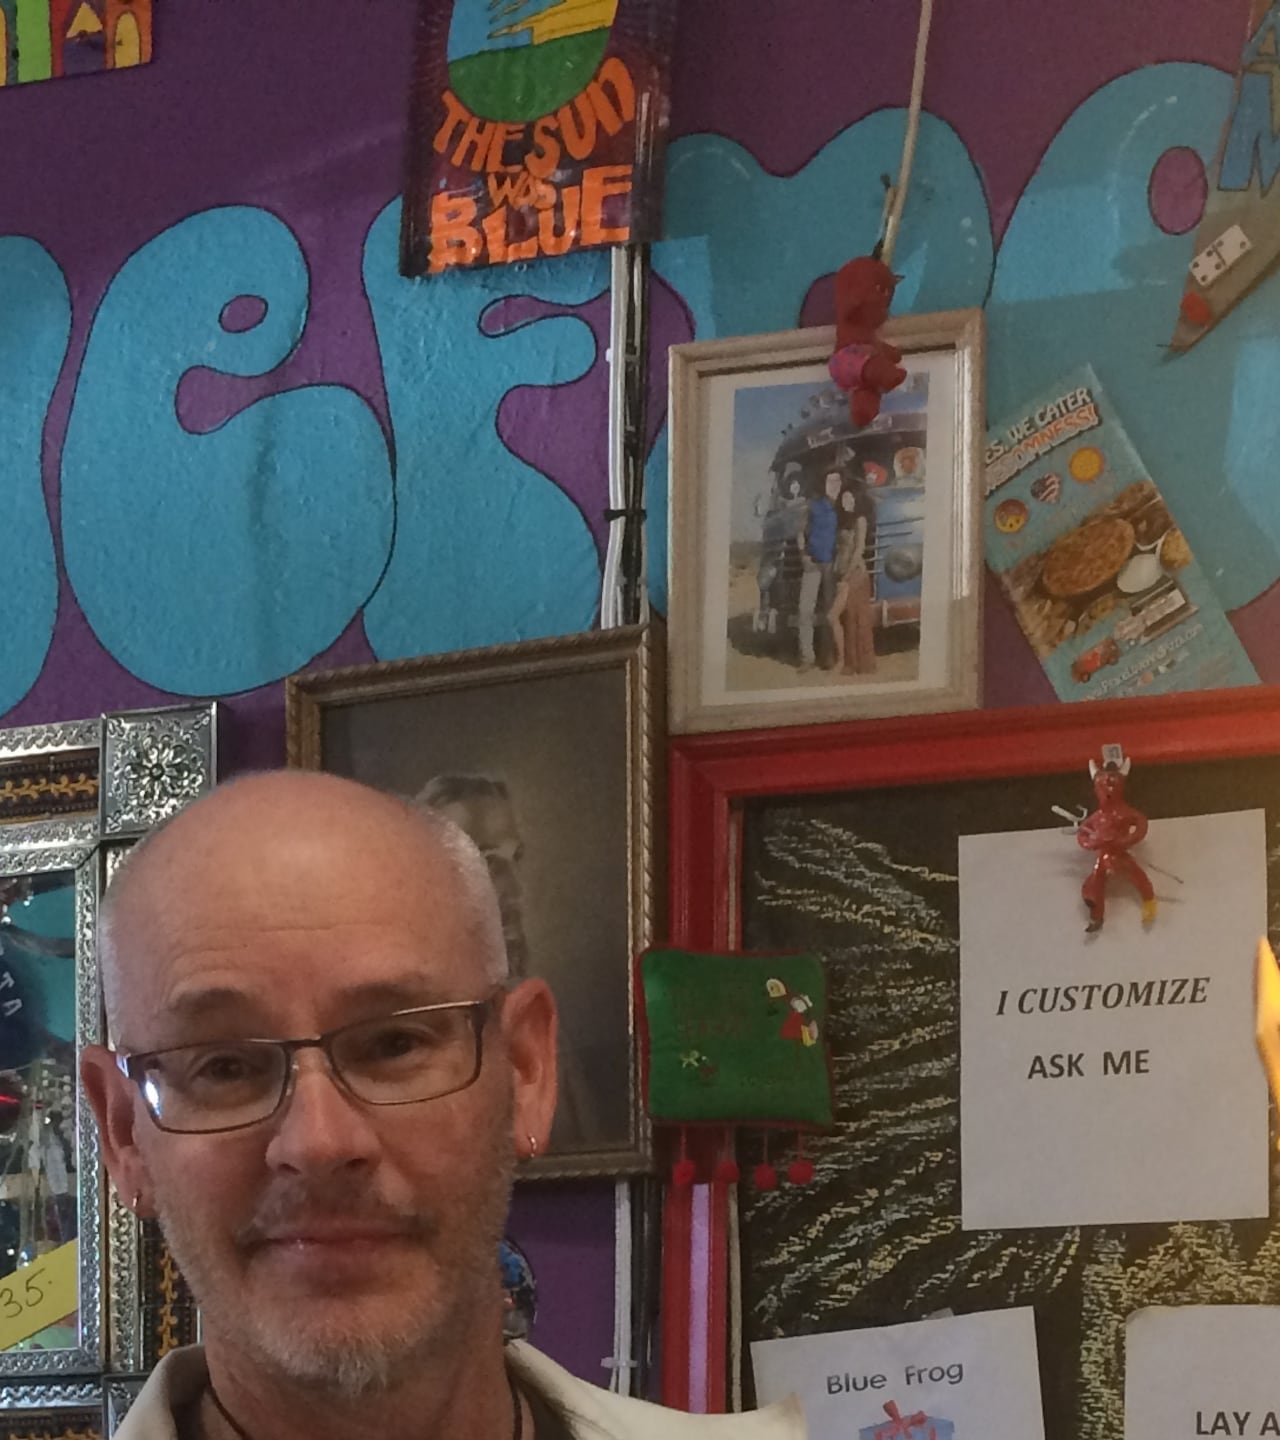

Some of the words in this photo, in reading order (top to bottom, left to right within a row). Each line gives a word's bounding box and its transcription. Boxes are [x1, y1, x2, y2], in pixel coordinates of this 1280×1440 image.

[433, 90, 524, 173] THE
[525, 57, 635, 178] SUN
[488, 172, 556, 209] WAS
[428, 164, 633, 274] BLUE
[1007, 416, 1035, 443] WE
[1034, 387, 1092, 427] CATER
[995, 990, 1009, 1016] I
[1018, 977, 1211, 1014] CUSTOMIZE
[1027, 1052, 1085, 1079] ASK
[1103, 1049, 1150, 1075] ME
[826, 1372, 887, 1395] Blue
[905, 1363, 964, 1386] Frog
[1195, 1411, 1251, 1436] LAY
